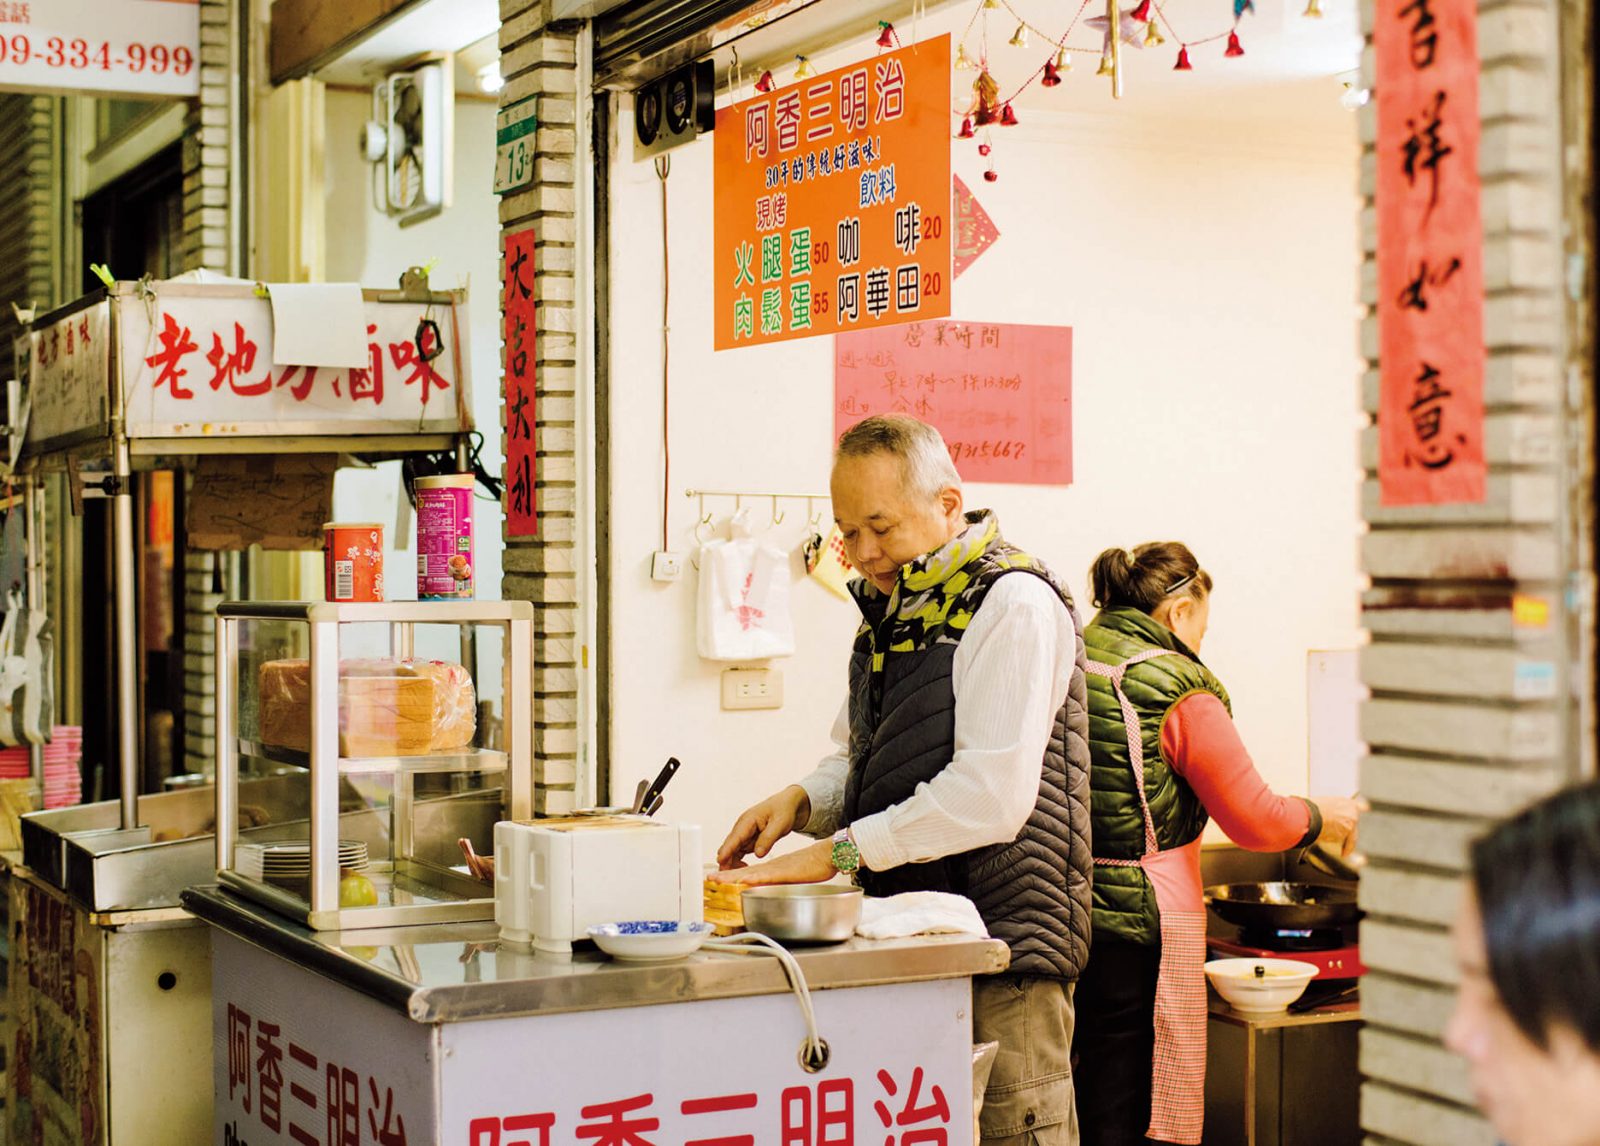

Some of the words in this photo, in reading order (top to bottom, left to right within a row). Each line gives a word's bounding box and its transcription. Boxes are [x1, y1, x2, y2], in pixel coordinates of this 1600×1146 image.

[747, 61, 904, 161] 阿香三明治
[861, 165, 895, 205] 飲料
[757, 194, 786, 229] 現烤
[924, 216, 941, 239] 20
[735, 230, 811, 286] 火腿蛋
[814, 242, 829, 265] 50
[735, 283, 811, 337] 肉鬆蛋
[814, 292, 829, 315] 55
[838, 266, 918, 322] 阿華田
[924, 272, 941, 296] 20
[904, 323, 1000, 349] 營業時間
[510, 246, 531, 517] 大吉大利
[946, 439, 1026, 462] 9315667
